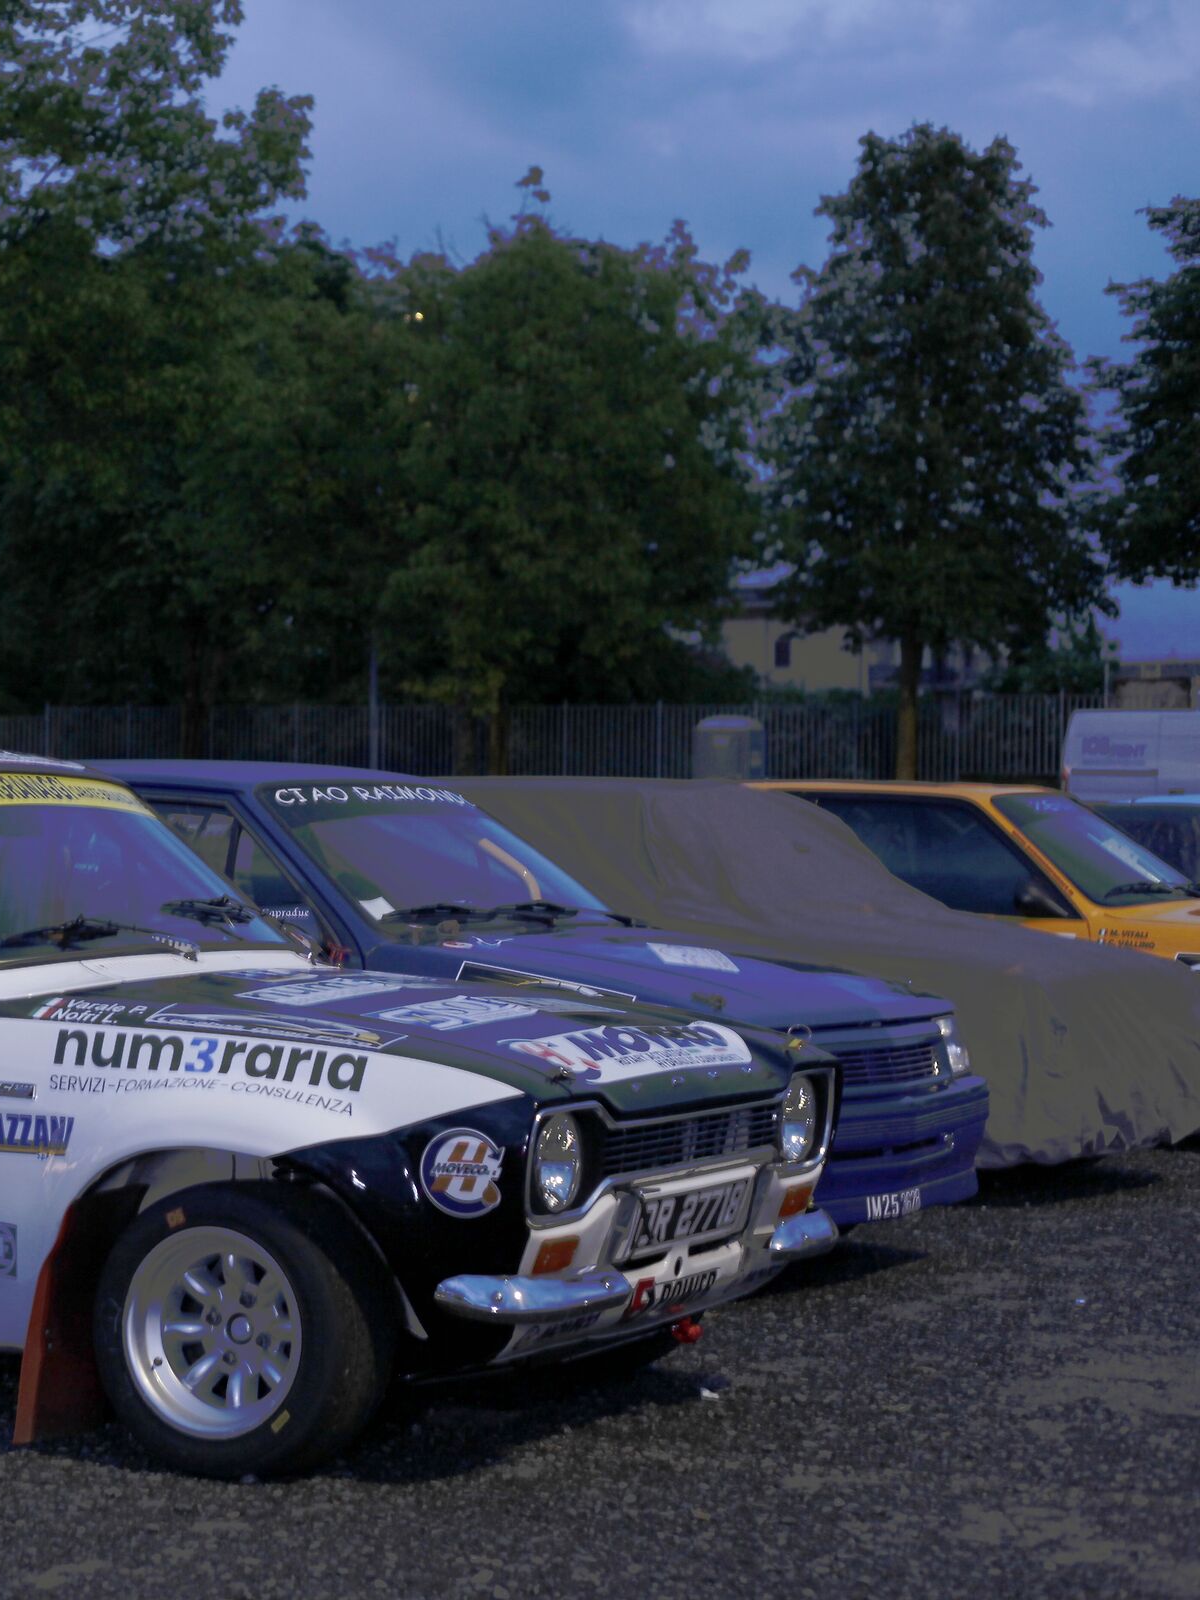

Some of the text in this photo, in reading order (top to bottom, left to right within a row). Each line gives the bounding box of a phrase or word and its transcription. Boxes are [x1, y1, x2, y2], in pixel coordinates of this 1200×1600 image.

[275, 786, 349, 804] CIAO
[53, 1028, 368, 1092] num3raria
[430, 1162, 490, 1177] MOVECO
